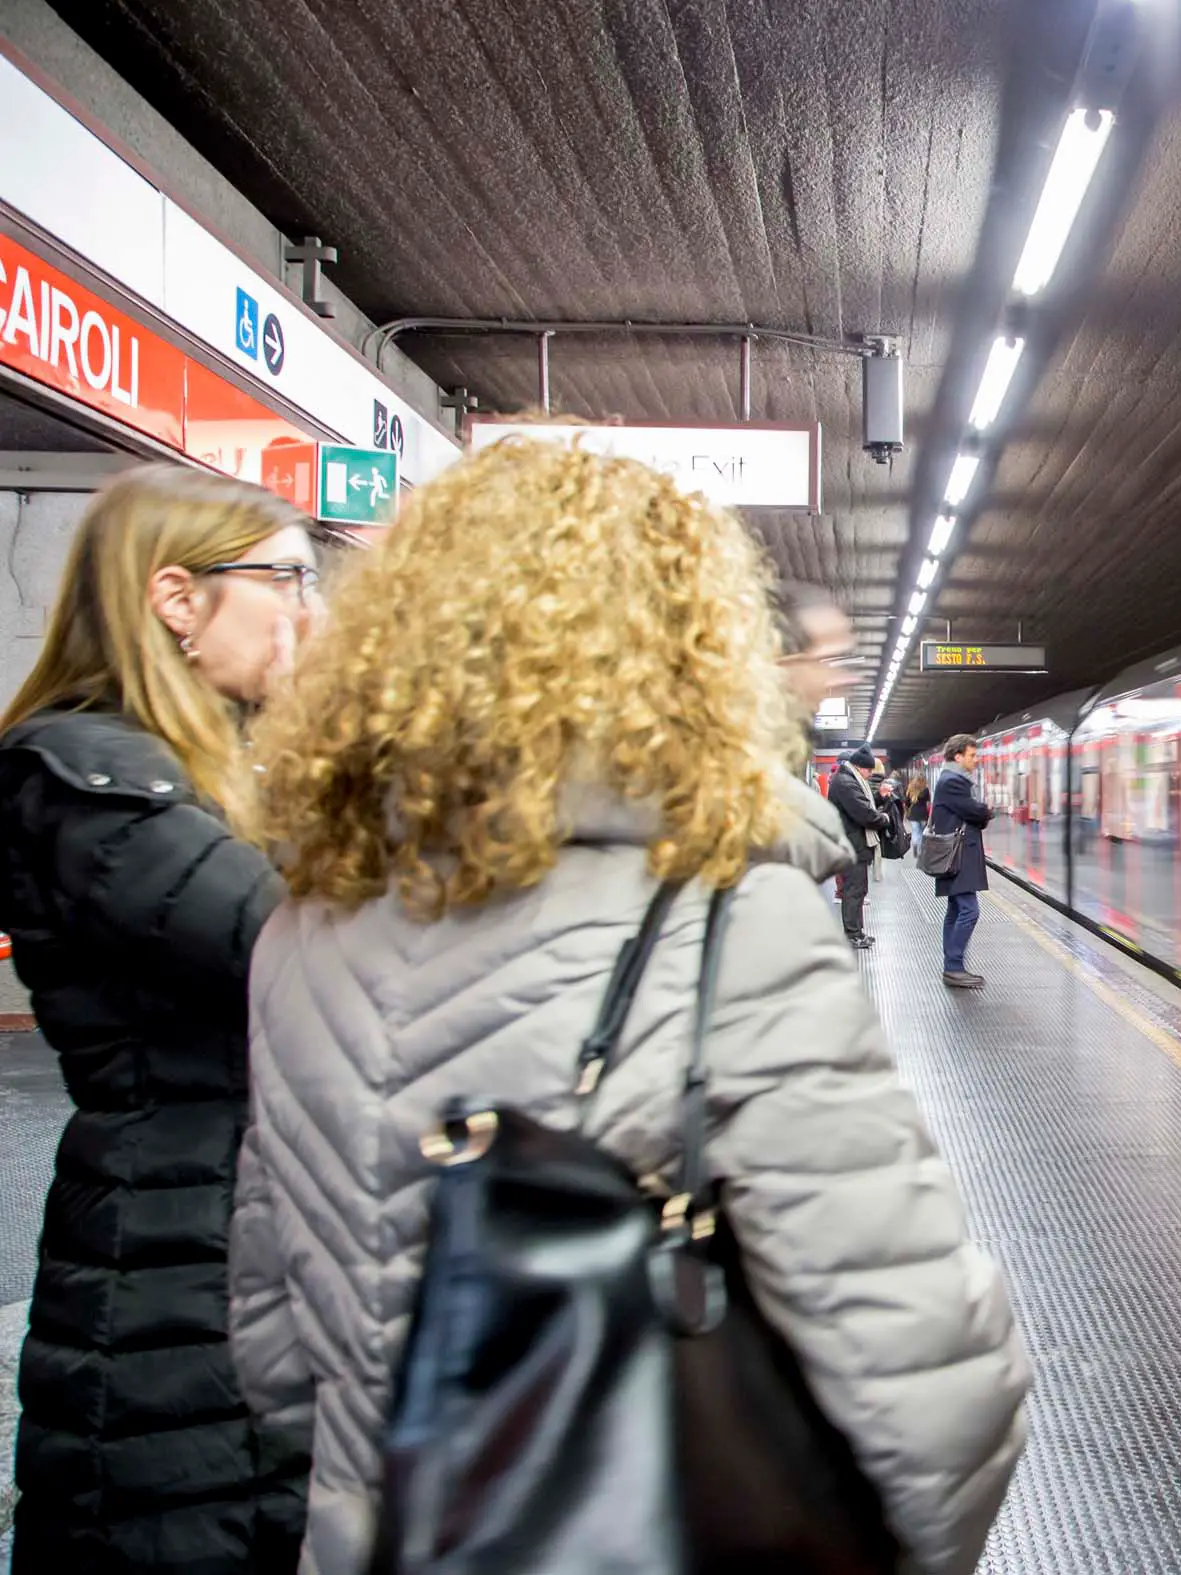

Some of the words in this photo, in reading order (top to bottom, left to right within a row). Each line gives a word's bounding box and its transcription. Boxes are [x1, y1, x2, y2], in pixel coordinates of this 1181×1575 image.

[0, 258, 139, 408] AIROLI
[692, 455, 747, 483] Exit
[936, 654, 962, 665] SESTO
